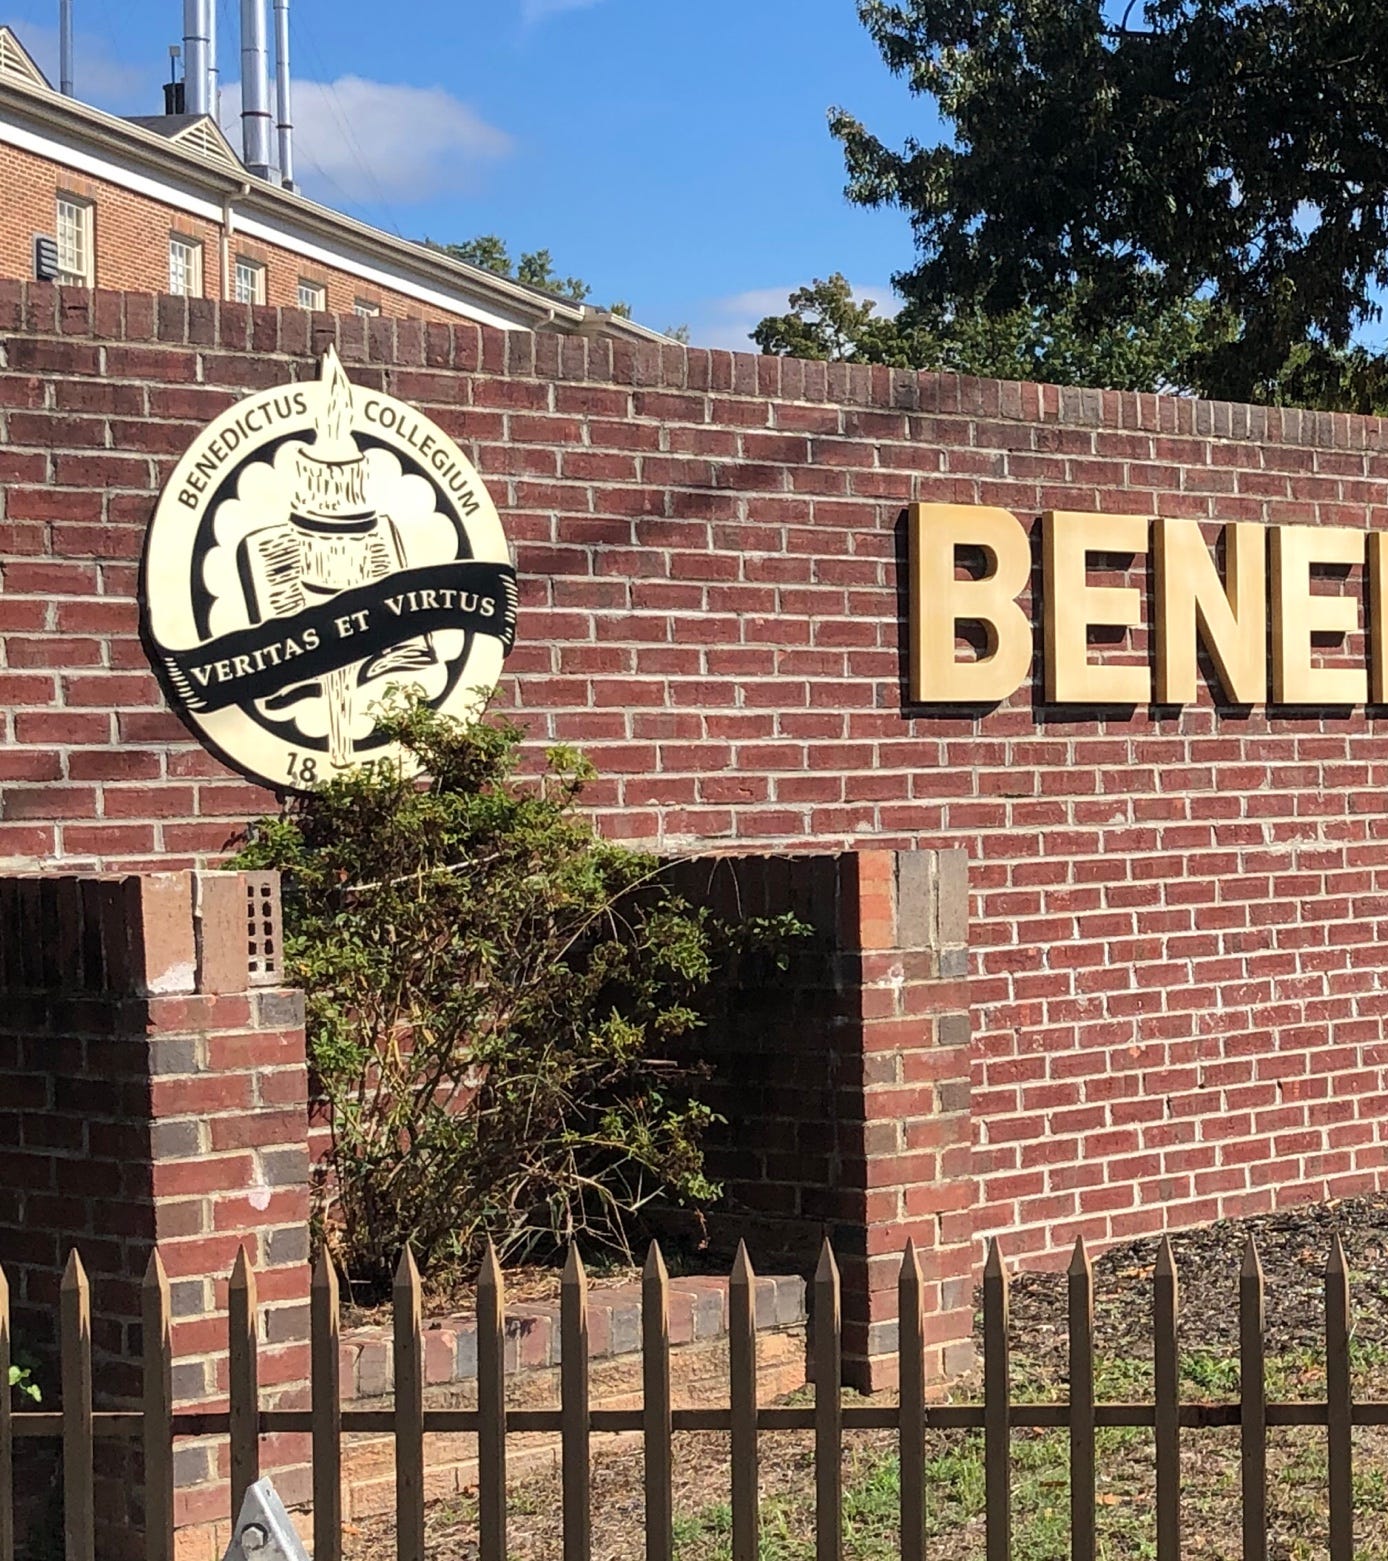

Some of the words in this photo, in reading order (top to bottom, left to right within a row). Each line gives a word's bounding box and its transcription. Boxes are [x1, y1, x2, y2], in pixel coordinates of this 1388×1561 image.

[178, 391, 308, 511] BENEDICTUS
[363, 399, 481, 518] COLLEGIUM
[190, 628, 321, 687] VERITAS
[334, 609, 370, 639] ET
[384, 588, 497, 618] VIRTUS
